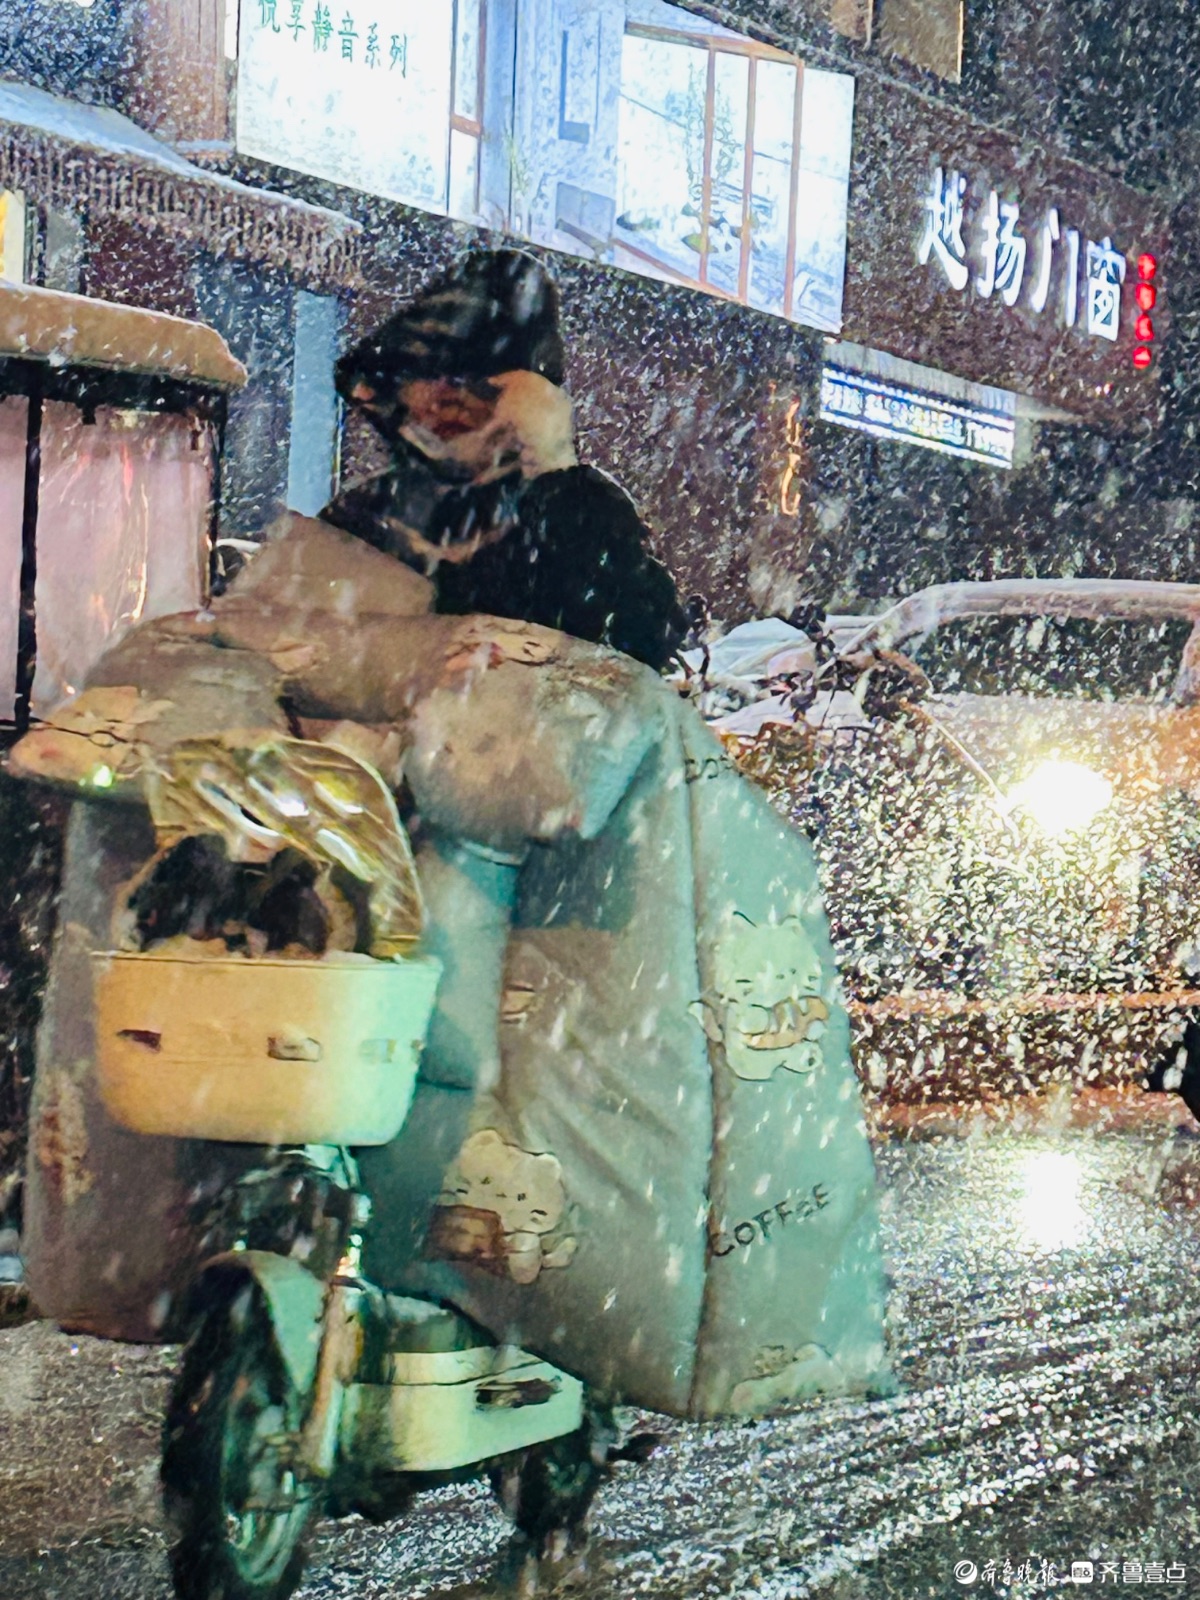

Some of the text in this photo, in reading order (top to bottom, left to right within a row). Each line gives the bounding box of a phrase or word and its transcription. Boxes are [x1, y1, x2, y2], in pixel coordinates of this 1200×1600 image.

[918, 166, 1126, 341] 越扬门窗
[711, 1183, 829, 1257] COFFEE
